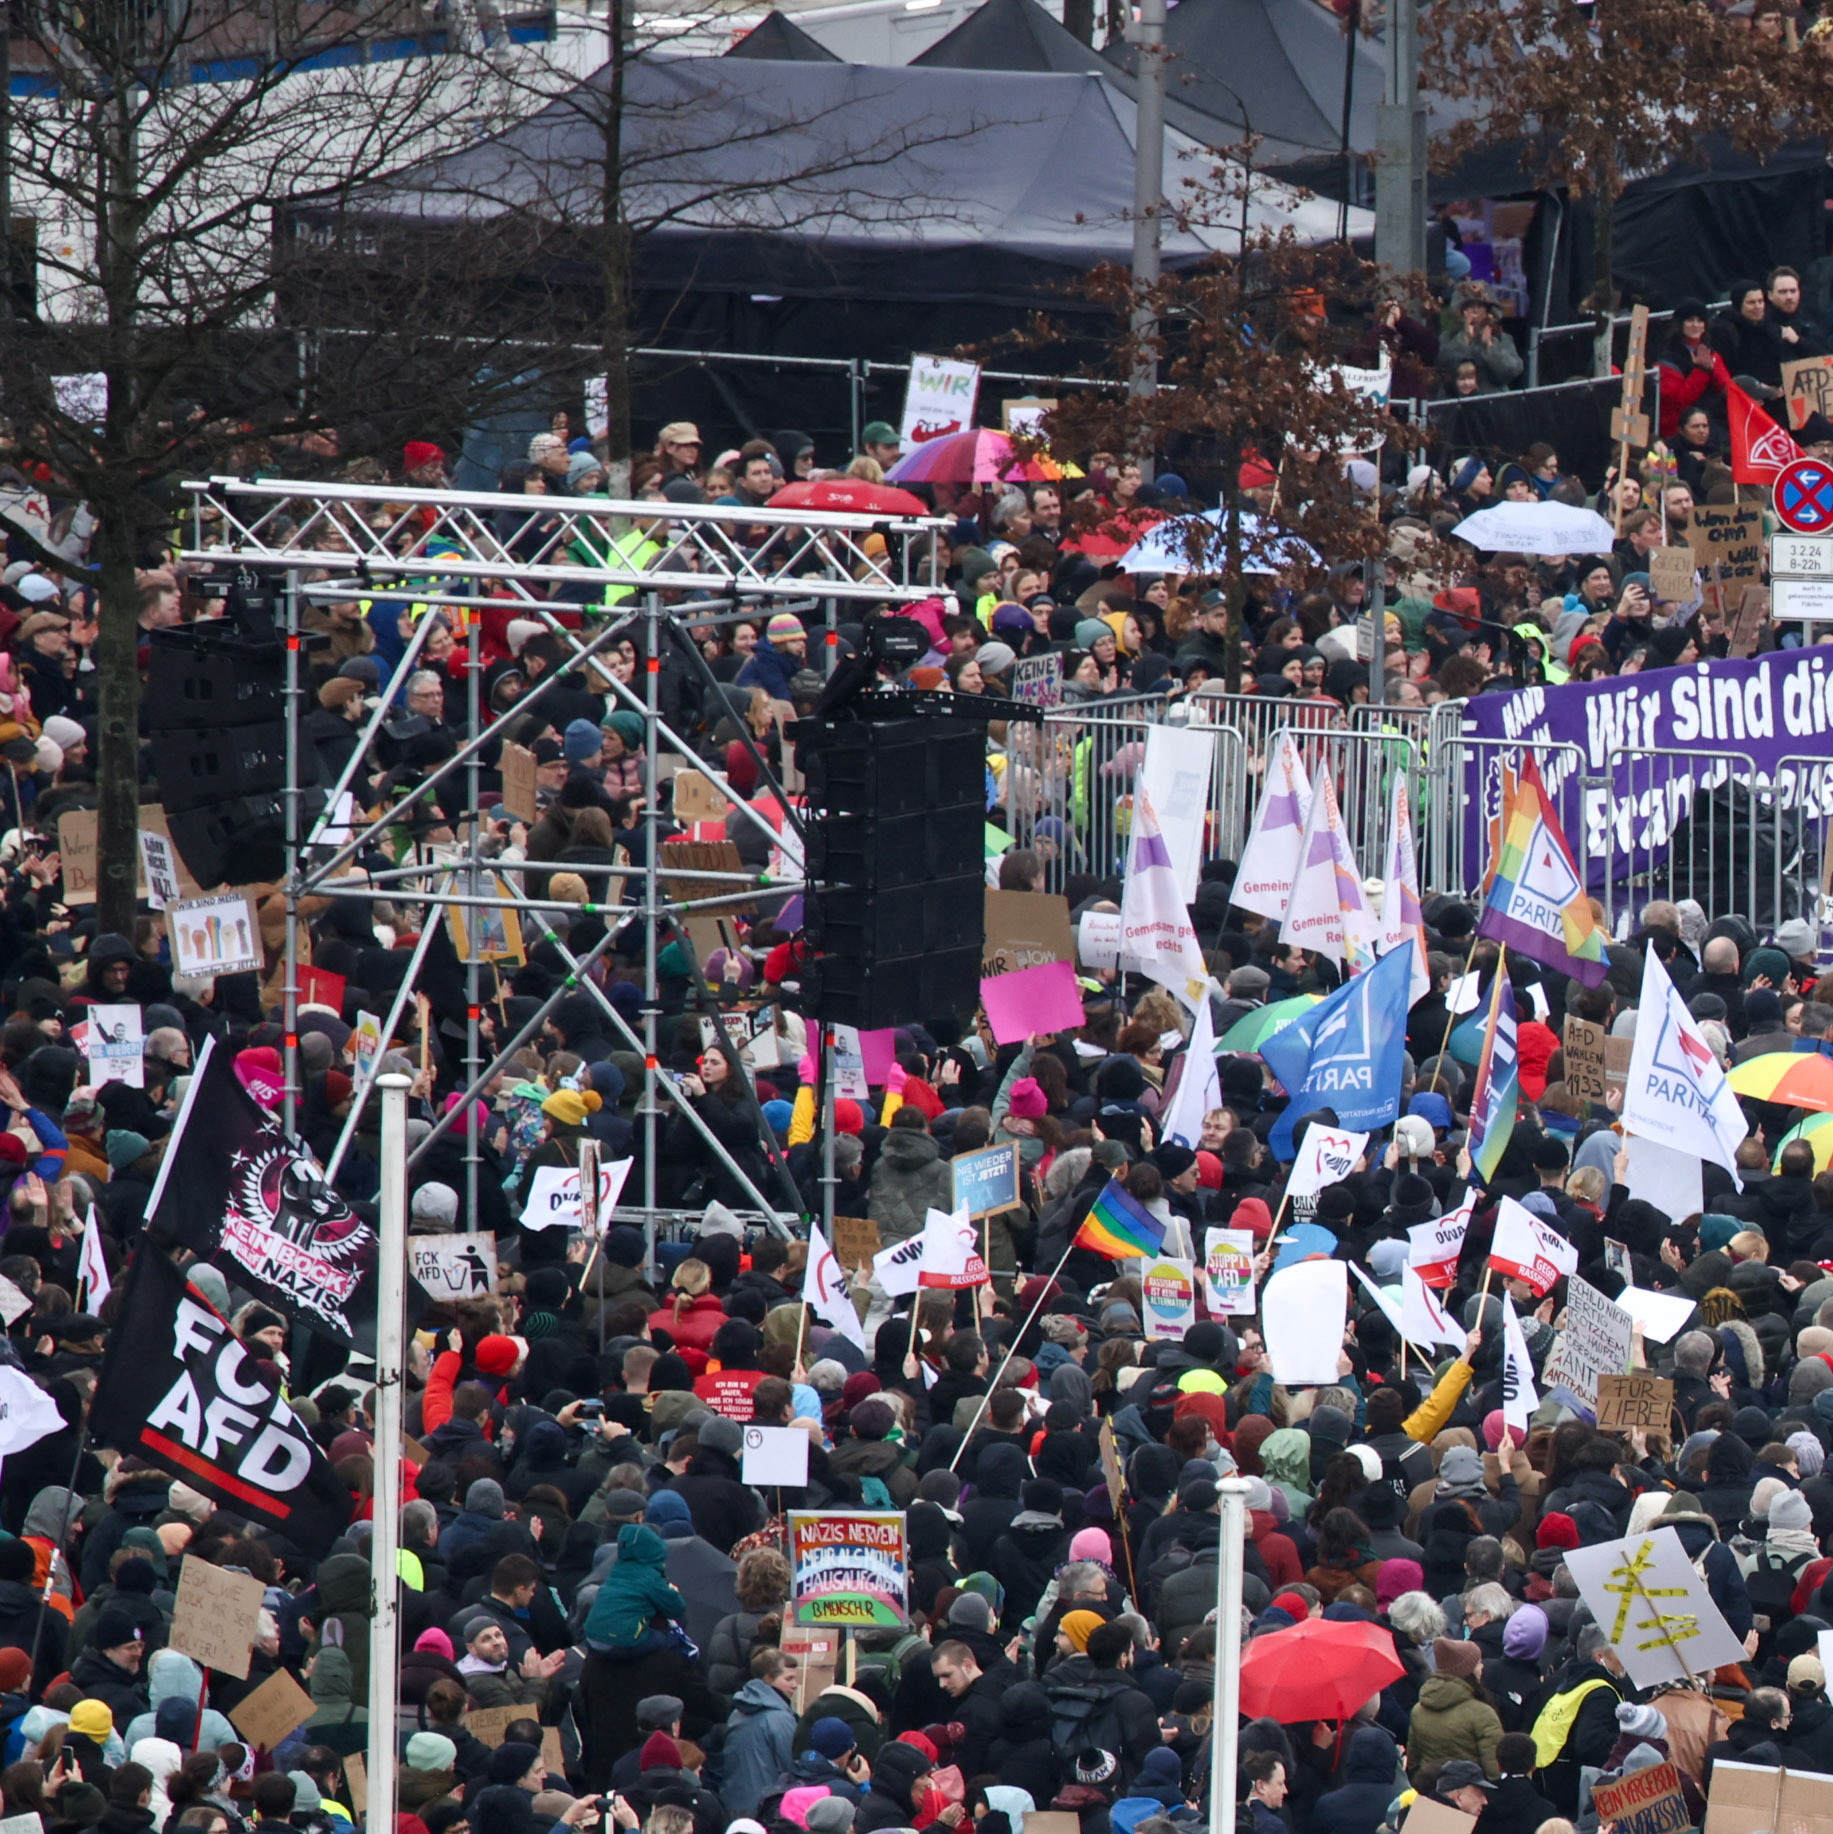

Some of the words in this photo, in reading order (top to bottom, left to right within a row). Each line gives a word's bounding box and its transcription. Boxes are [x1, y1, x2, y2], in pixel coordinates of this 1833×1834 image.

[1790, 545, 1822, 557] 3.2.24
[1790, 559, 1821, 572] 8-22h
[1501, 685, 1546, 739] HAND
[1585, 685, 1661, 768] Wir
[1567, 1077, 1604, 1098] 1933
[956, 1162, 973, 1176] NIE
[974, 1150, 1012, 1169] WIEDER
[962, 1173, 976, 1186] IST
[222, 1209, 282, 1256] KEIN
[278, 1240, 350, 1296] BOCK
[415, 1252, 439, 1265] FCK
[417, 1267, 441, 1281] AFD
[1148, 1277, 1184, 1290] RASSISMUS
[1216, 1269, 1240, 1288] AFD
[1150, 1297, 1189, 1309] ALTERNATIVE
[1613, 1377, 1653, 1399] FÜR
[1600, 1399, 1670, 1429] LIEBE!
[146, 1369, 312, 1494] AFD
[799, 1522, 844, 1543] NAZIS
[848, 1522, 899, 1545] NERVEN
[1593, 1783, 1627, 1819] KEIN
[1625, 1762, 1679, 1808] VERGEBEN
